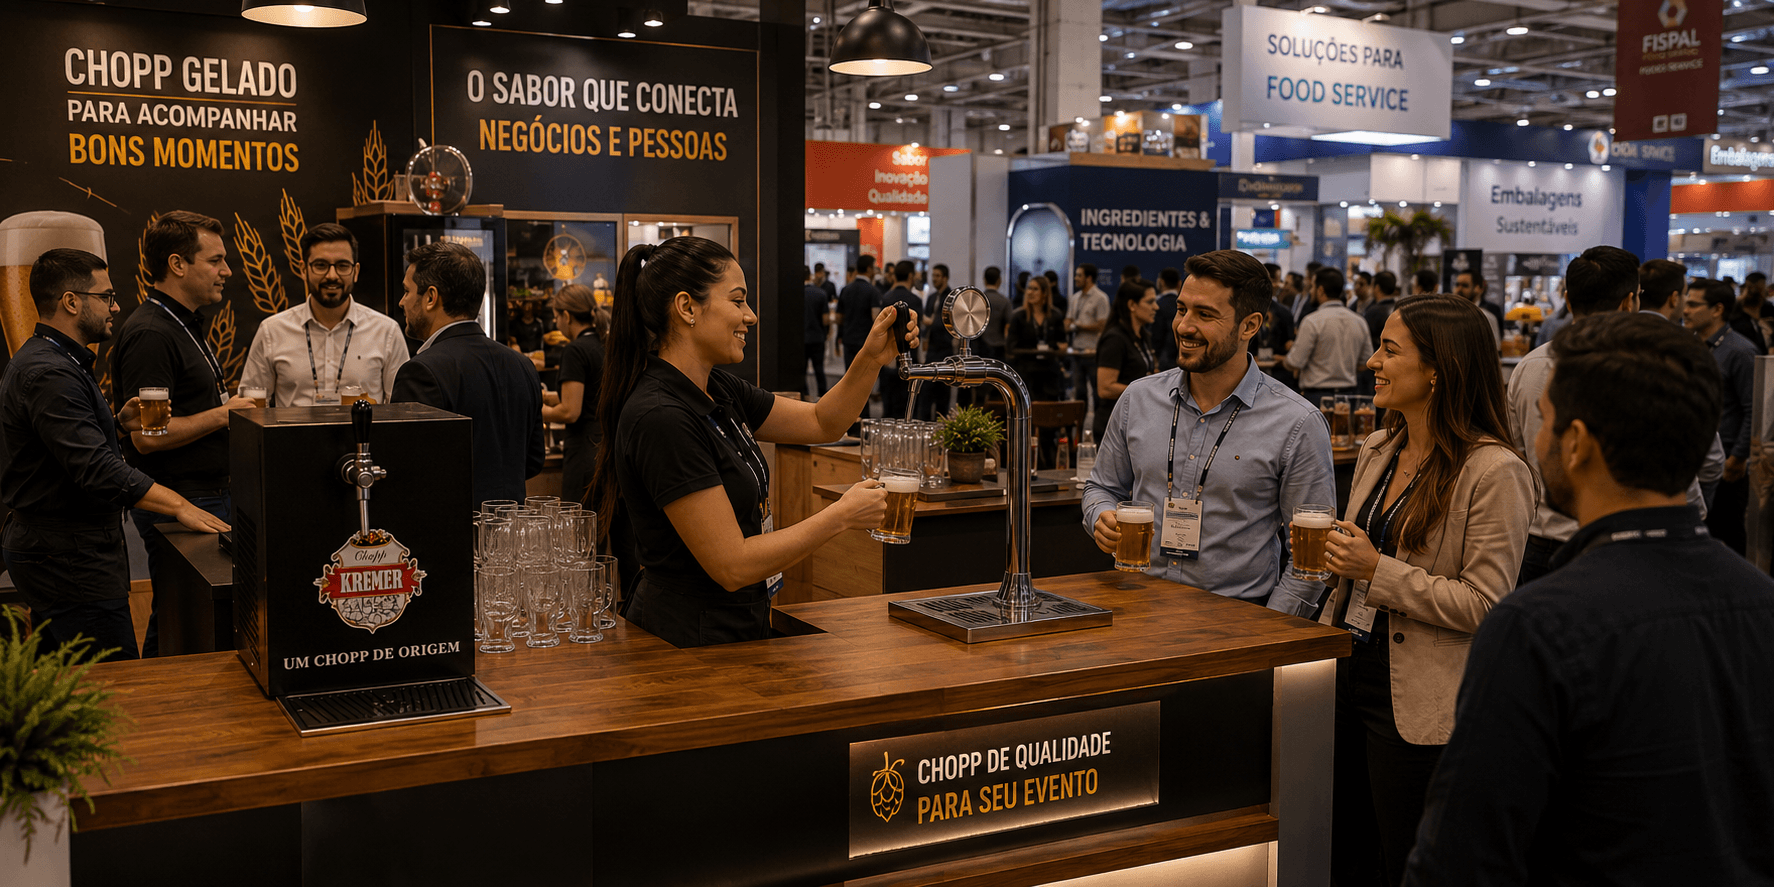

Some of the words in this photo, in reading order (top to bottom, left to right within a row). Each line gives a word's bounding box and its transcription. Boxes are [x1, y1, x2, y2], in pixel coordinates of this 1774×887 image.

[1267, 33, 1358, 65] SOLUÇÕES
[1363, 46, 1404, 69] PARA
[1642, 28, 1701, 53] FISPAL
[64, 47, 172, 90] CHOPP
[182, 55, 297, 99] GELADO
[467, 69, 485, 102] O
[492, 71, 576, 108] SABOR
[582, 77, 630, 112] QUE
[636, 81, 739, 118] CONECTA
[1267, 75, 1325, 102] FOOD
[1331, 82, 1409, 111] SERVICE
[67, 99, 131, 124] PARA
[136, 102, 298, 132] ACOMPANHAR
[479, 114, 601, 156] NEGÓCIOS
[608, 126, 622, 156] E
[628, 127, 728, 161] PESSOAS
[69, 132, 146, 167] BONS
[153, 136, 300, 173] MOMENTOS
[892, 150, 928, 166] Sabor
[874, 169, 928, 187] Inovação
[868, 188, 928, 204] Qualidade
[1491, 184, 1583, 212] Embalagens
[1080, 208, 1197, 229] INGREDIENTES
[1199, 211, 1210, 229] &
[1080, 232, 1187, 252] TECNOLOGIA
[354, 549, 387, 564] Chopp
[340, 568, 404, 594] KREMER
[283, 656, 310, 670] UM
[313, 649, 369, 668] CHOPP
[372, 647, 394, 662] DE
[398, 641, 461, 659] ORIGEM
[917, 752, 983, 785] CHOPP
[987, 746, 1010, 774] DE
[1015, 730, 1112, 771] QUALIDADE
[917, 790, 973, 825] PARA
[979, 781, 1018, 814] SEU
[1024, 767, 1099, 807] EVENTO
